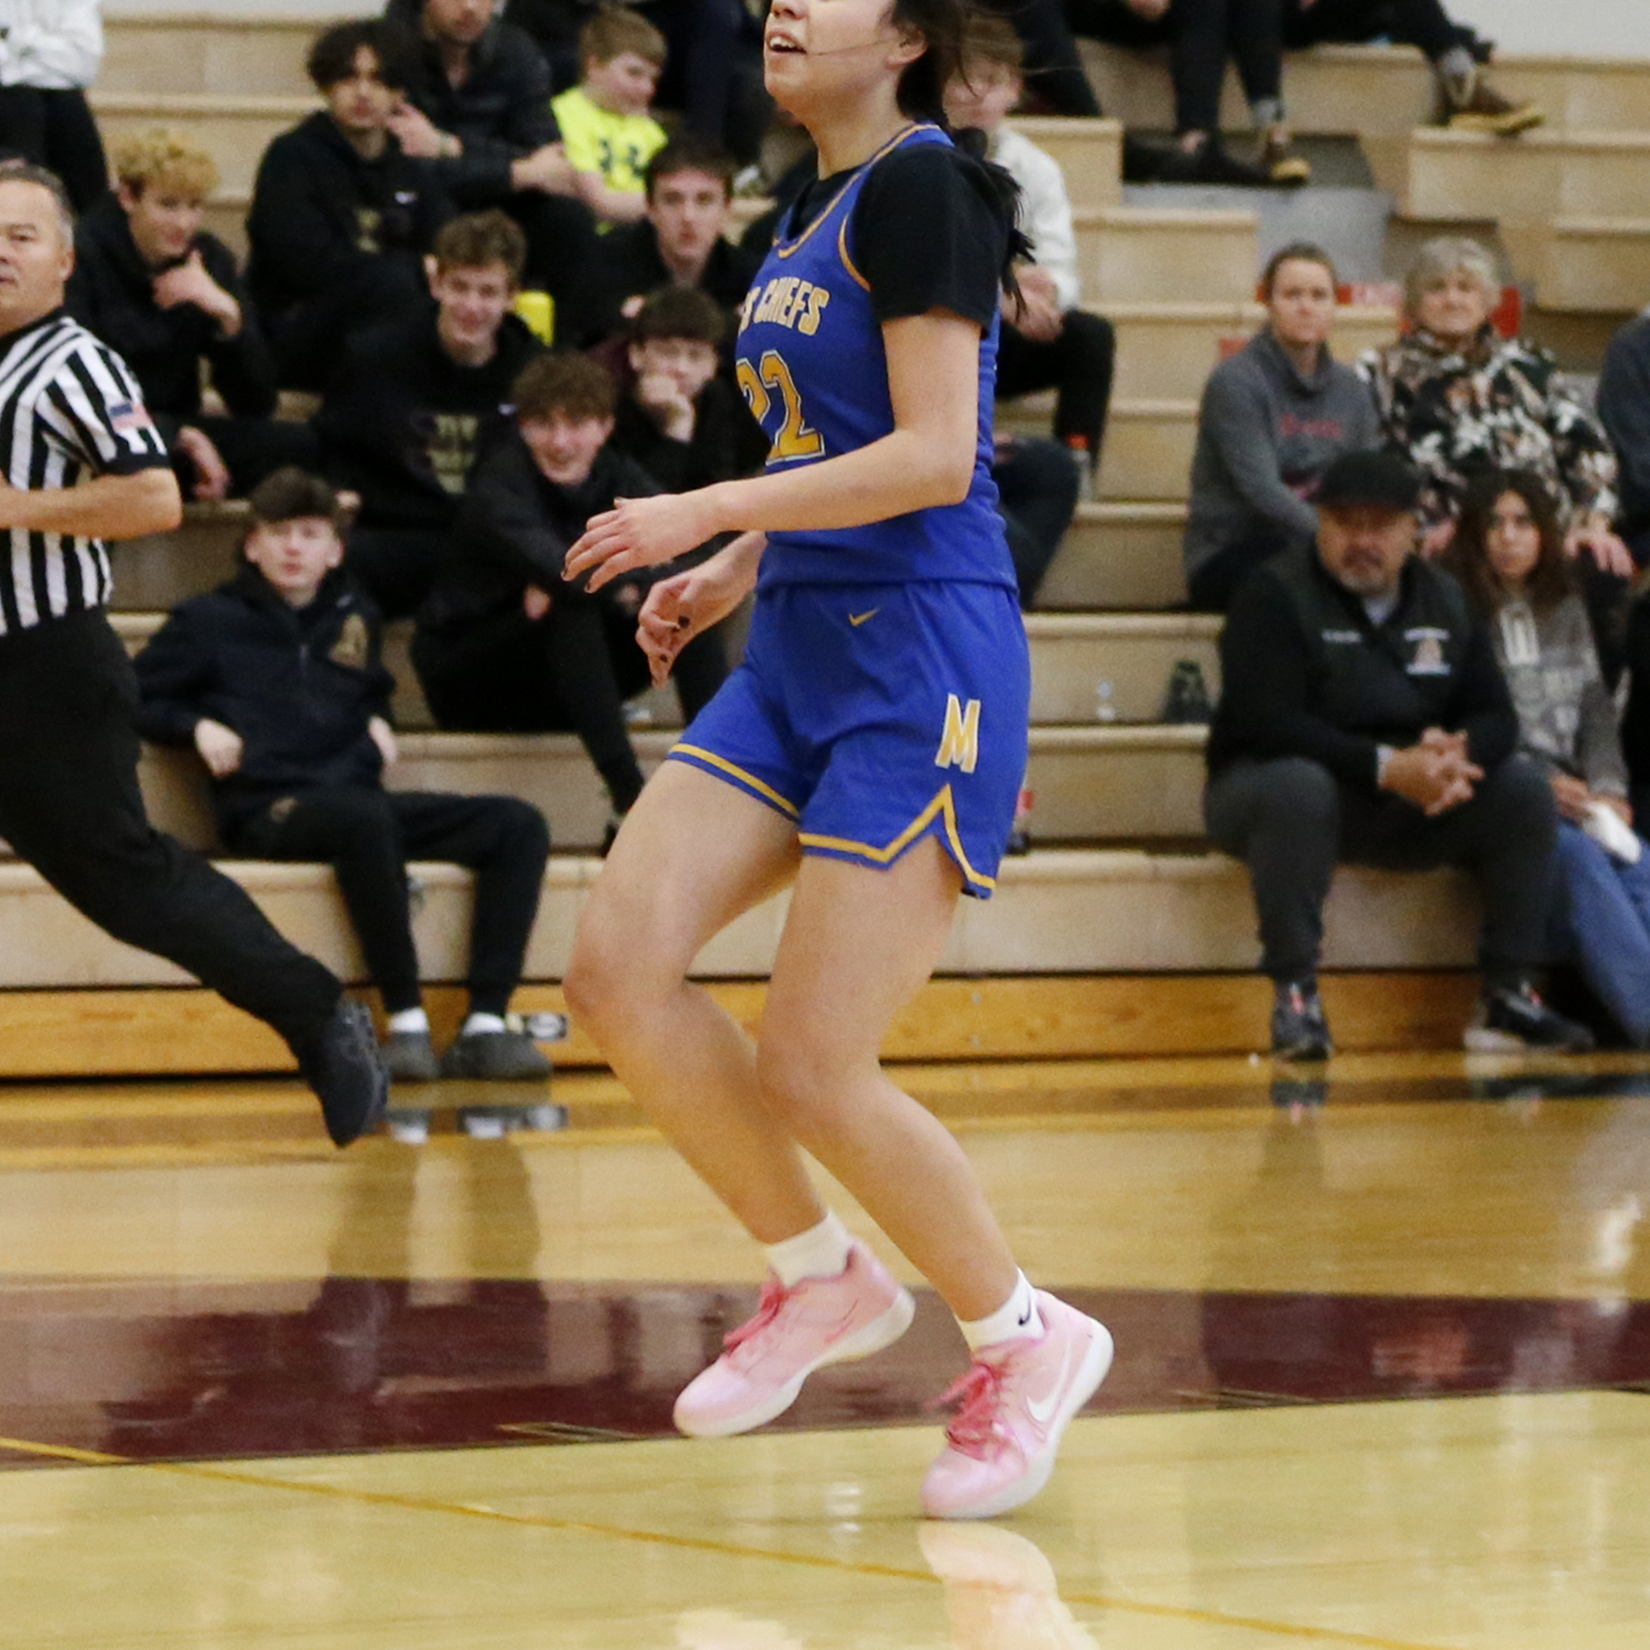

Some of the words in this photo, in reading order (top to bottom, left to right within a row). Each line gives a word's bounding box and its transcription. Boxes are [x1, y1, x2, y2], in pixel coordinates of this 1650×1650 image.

[753, 276, 830, 336] CHIEFS
[735, 349, 826, 466] 22
[934, 692, 981, 774] M
